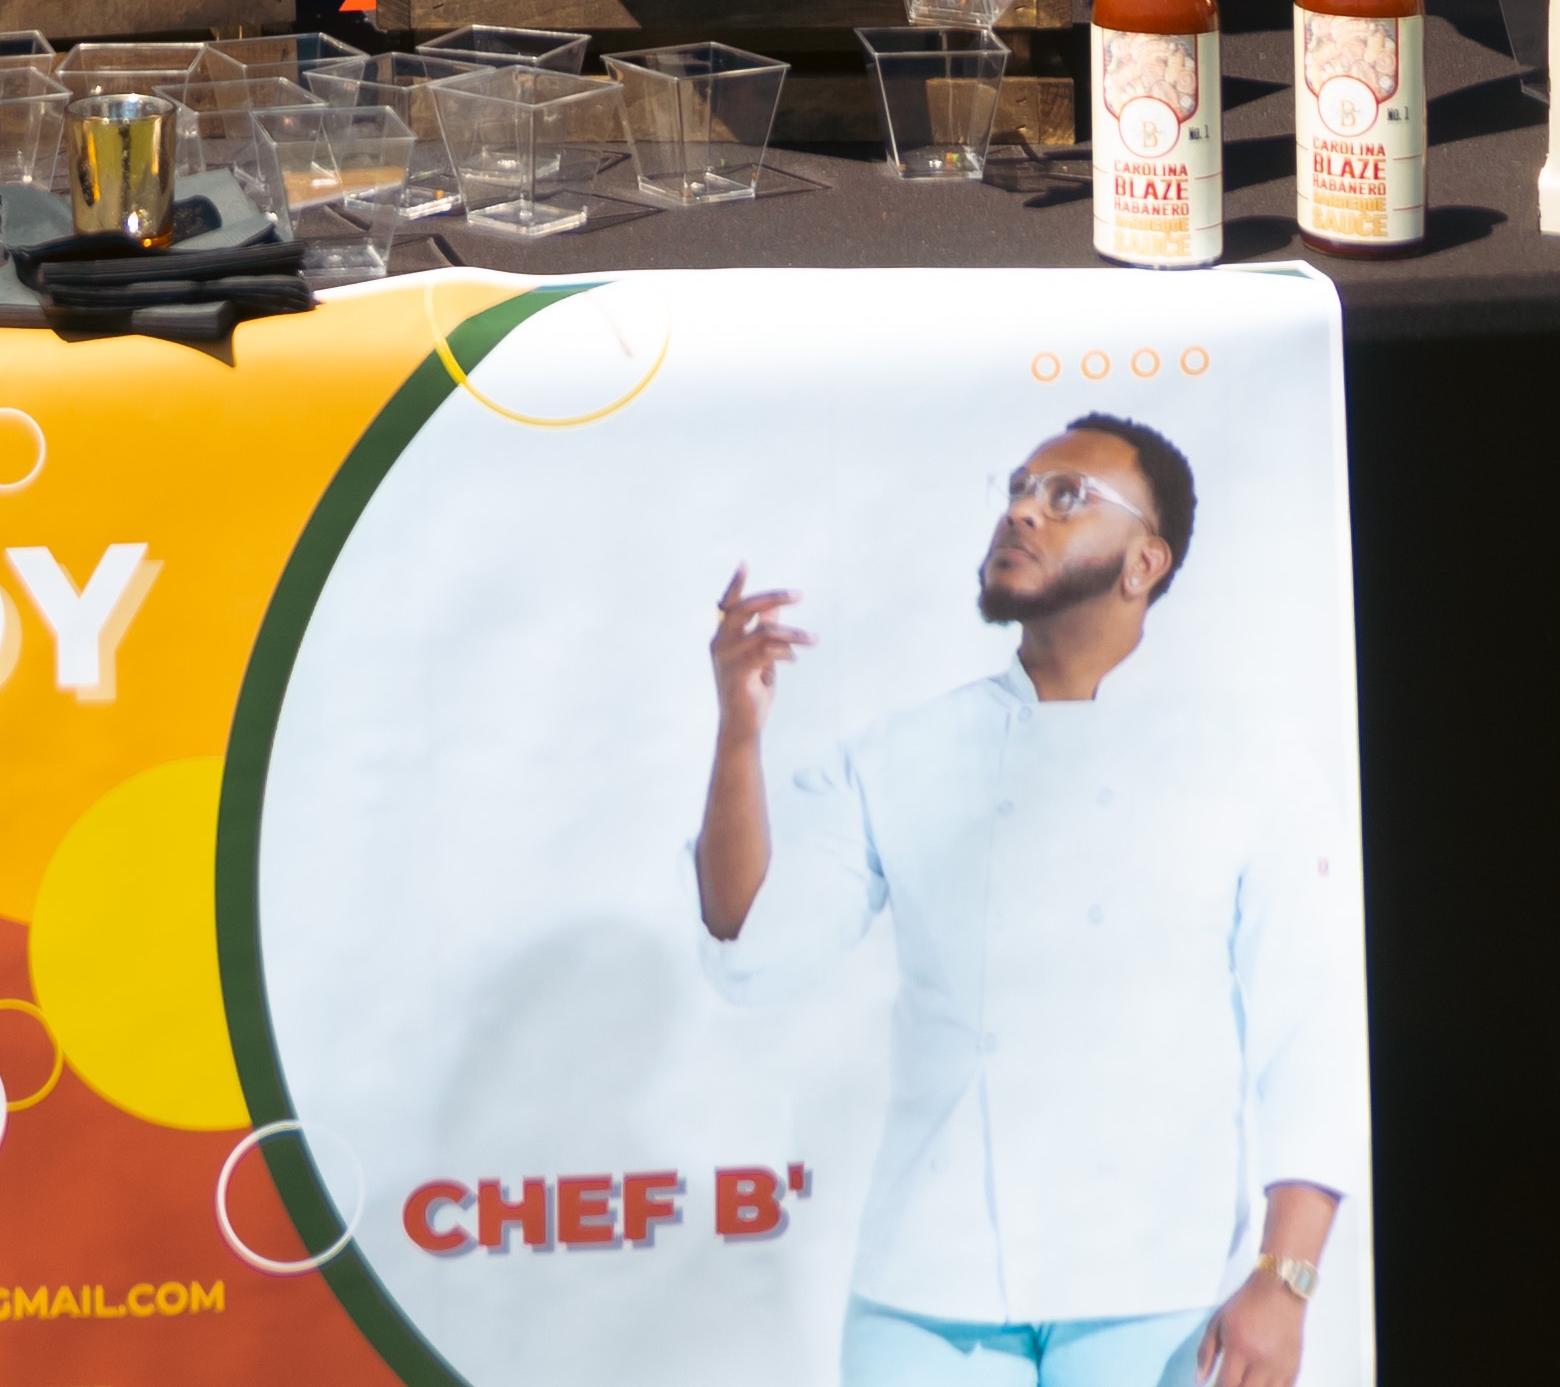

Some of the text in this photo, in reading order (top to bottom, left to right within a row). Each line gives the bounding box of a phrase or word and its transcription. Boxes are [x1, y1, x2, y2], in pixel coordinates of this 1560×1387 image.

[1313, 137, 1386, 157] CAROLINA
[1114, 160, 1188, 177] CAROLINA
[1313, 151, 1386, 180] BLAZE
[1115, 175, 1189, 201] BLAZE
[1312, 174, 1386, 196] HABANERO
[1114, 197, 1190, 216] HABANERO
[1312, 205, 1388, 237] SAUCE
[1114, 230, 1192, 257] SAUCE
[400, 1159, 814, 1255] CHEF B'
